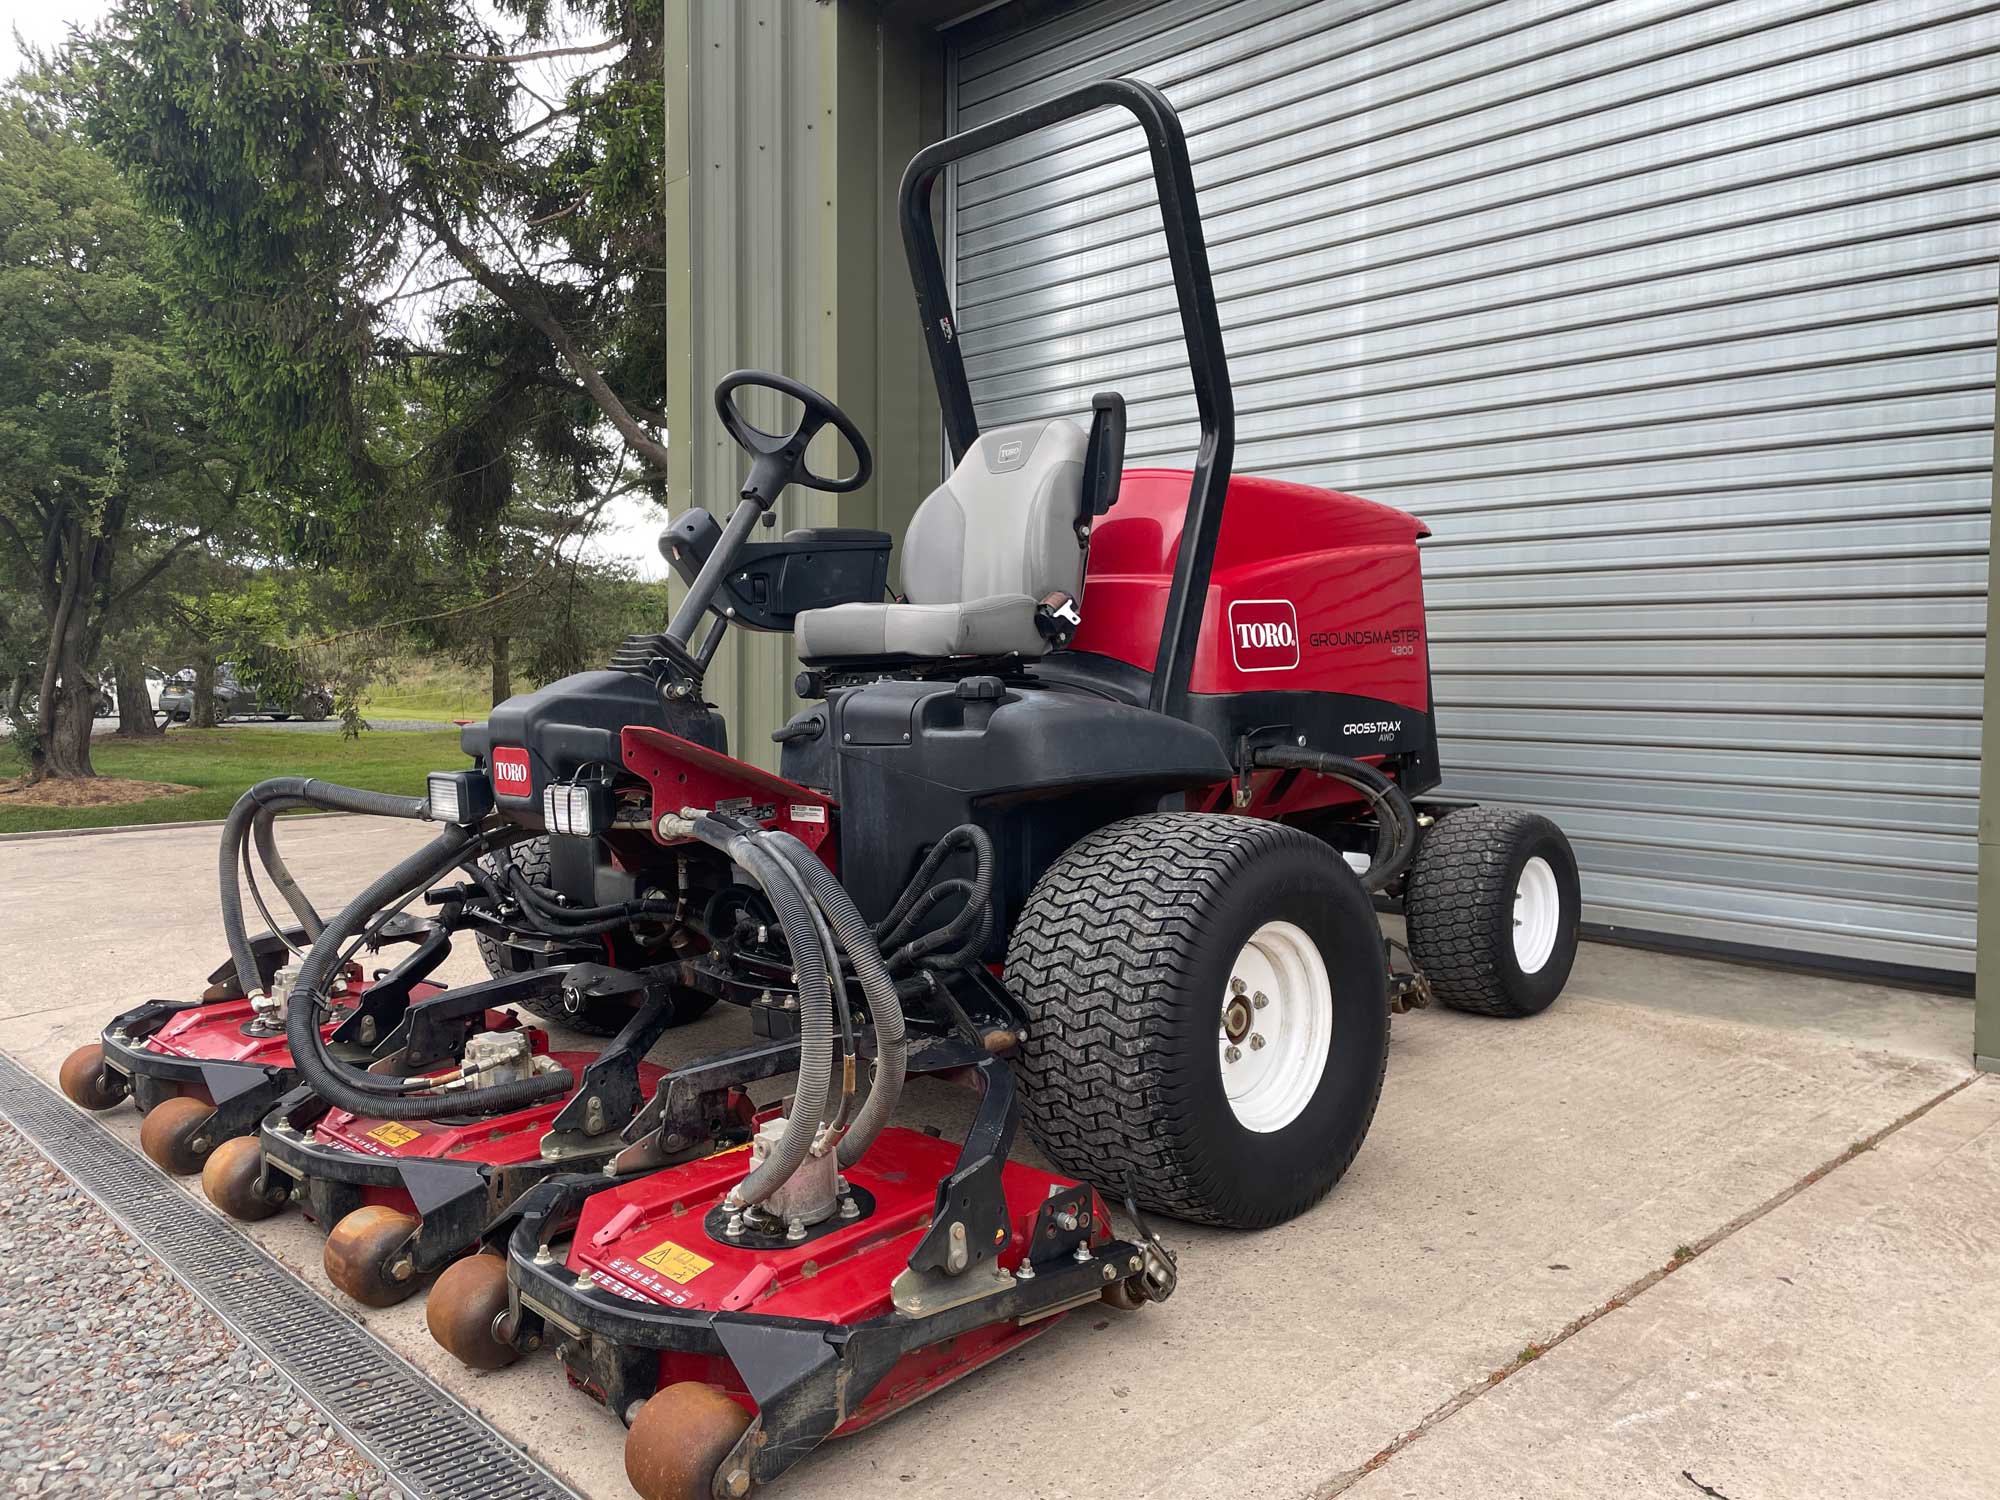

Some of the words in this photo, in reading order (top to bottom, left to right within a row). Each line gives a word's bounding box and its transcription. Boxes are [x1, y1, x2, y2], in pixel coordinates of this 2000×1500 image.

[1236, 622, 1294, 649] TORO
[1309, 629, 1421, 647] GROUNDSMASTER
[1391, 646, 1414, 656] 4300
[1343, 720, 1402, 735] CROSSTRAX
[1378, 732, 1395, 742] AWD
[495, 762, 527, 783] TORO
